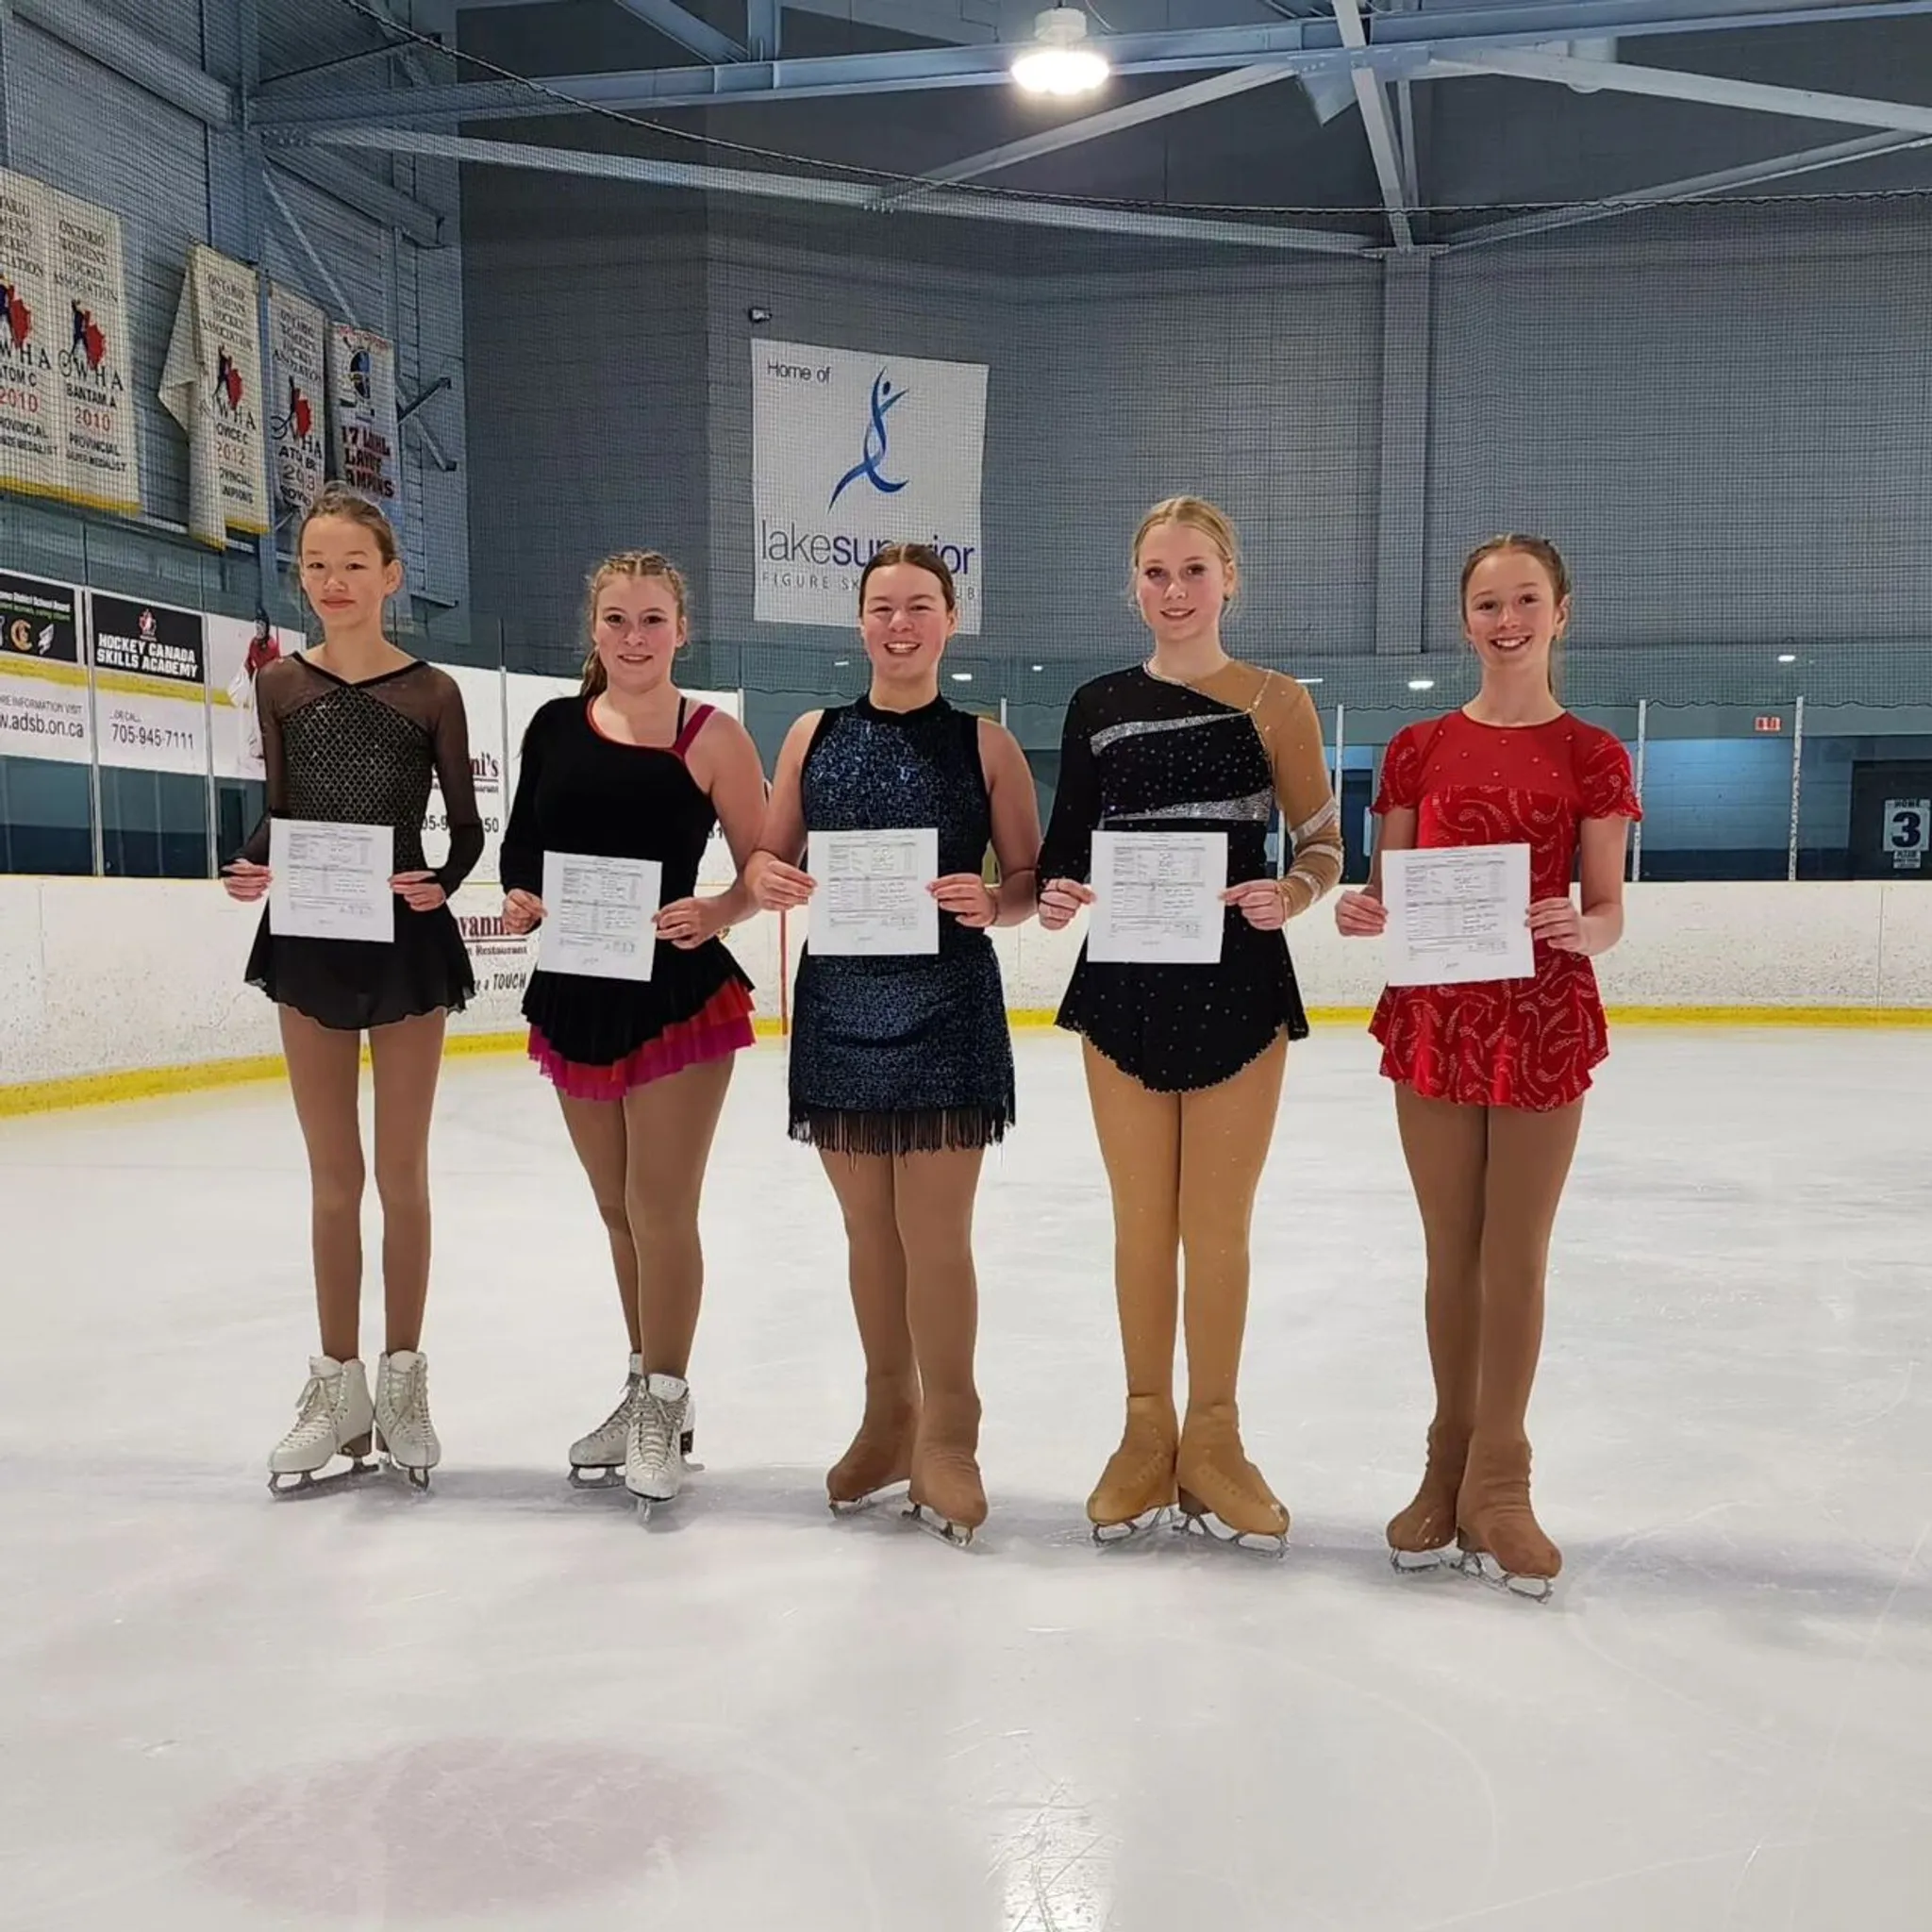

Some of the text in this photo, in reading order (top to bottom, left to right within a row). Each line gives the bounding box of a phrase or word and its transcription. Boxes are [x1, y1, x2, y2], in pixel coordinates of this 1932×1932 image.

[767, 359, 831, 383] Home of
[66, 383, 107, 406] BANTAM
[75, 407, 110, 431] 2010
[762, 520, 974, 575] lakesuior
[762, 571, 829, 590] FIGURE
[98, 633, 195, 663] HOCKEY CANADA
[97, 648, 198, 678] SKILLS ACADEMY
[111, 723, 193, 750] 705-945-7111
[1891, 811, 1921, 848] 3
[492, 974, 526, 991] TOUCH
